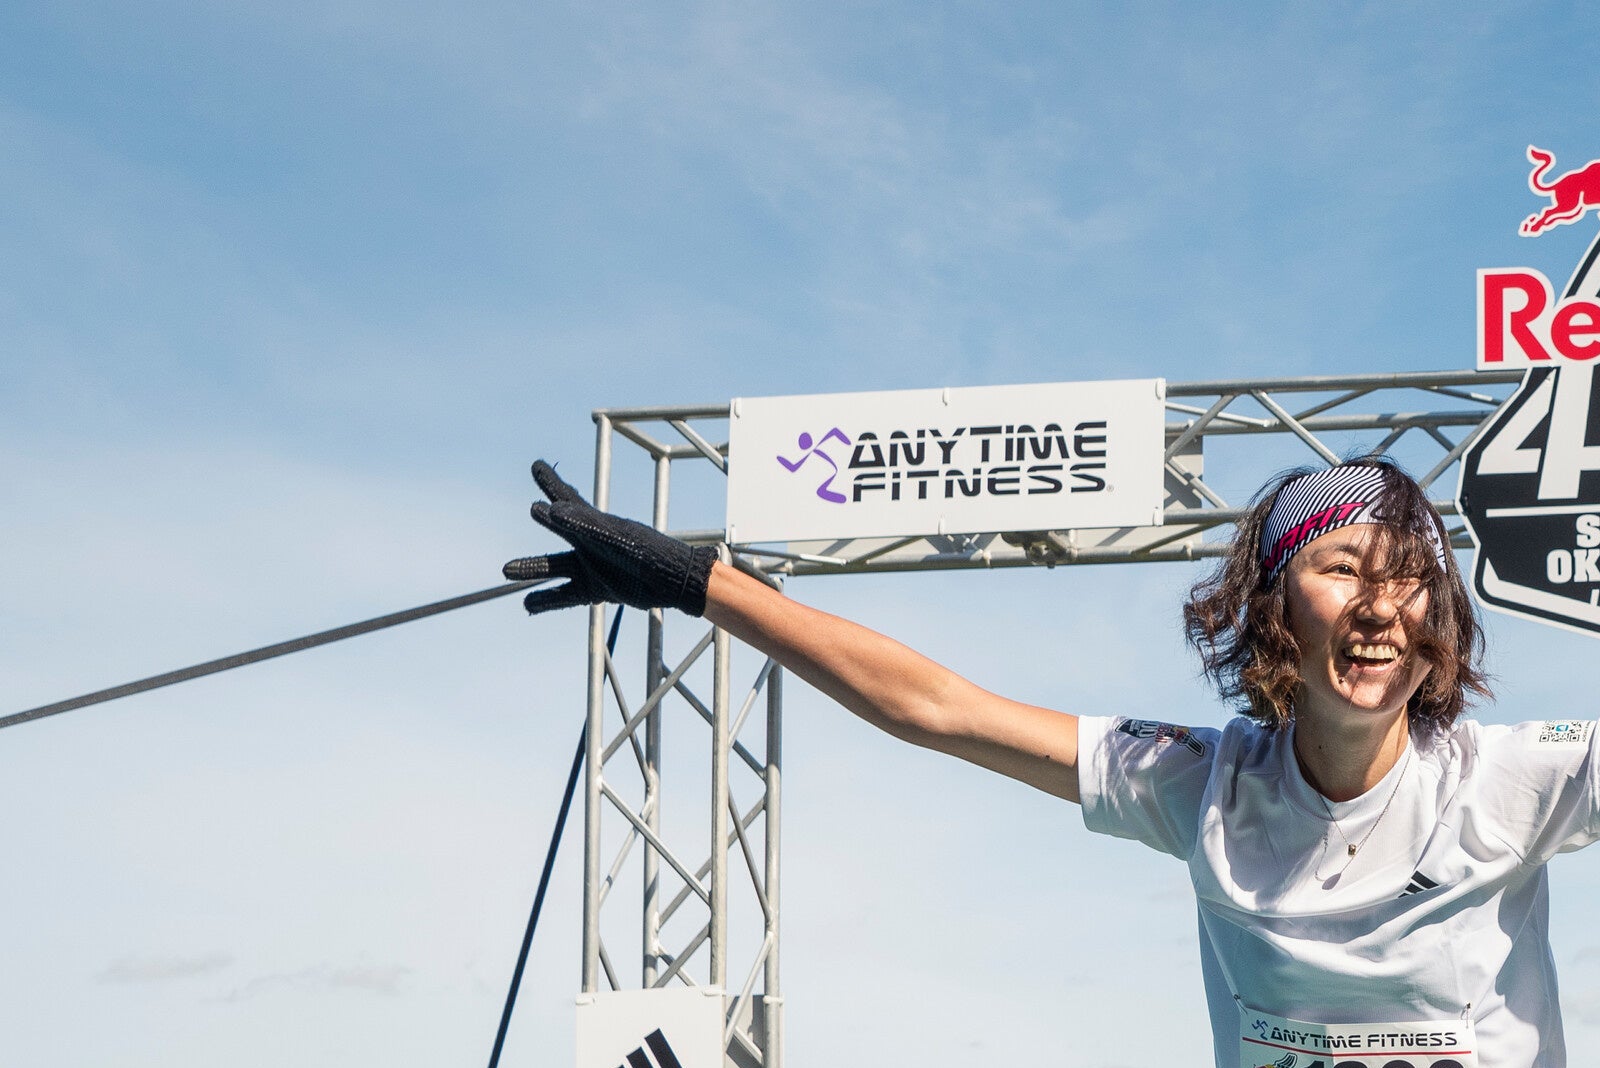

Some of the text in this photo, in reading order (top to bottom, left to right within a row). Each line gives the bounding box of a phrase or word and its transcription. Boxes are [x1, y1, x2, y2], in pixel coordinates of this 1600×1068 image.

[848, 420, 1108, 469] ANYTIME
[852, 462, 1107, 503] FITNESS
[1270, 1026, 1458, 1049] ANYTIME FITNESS
